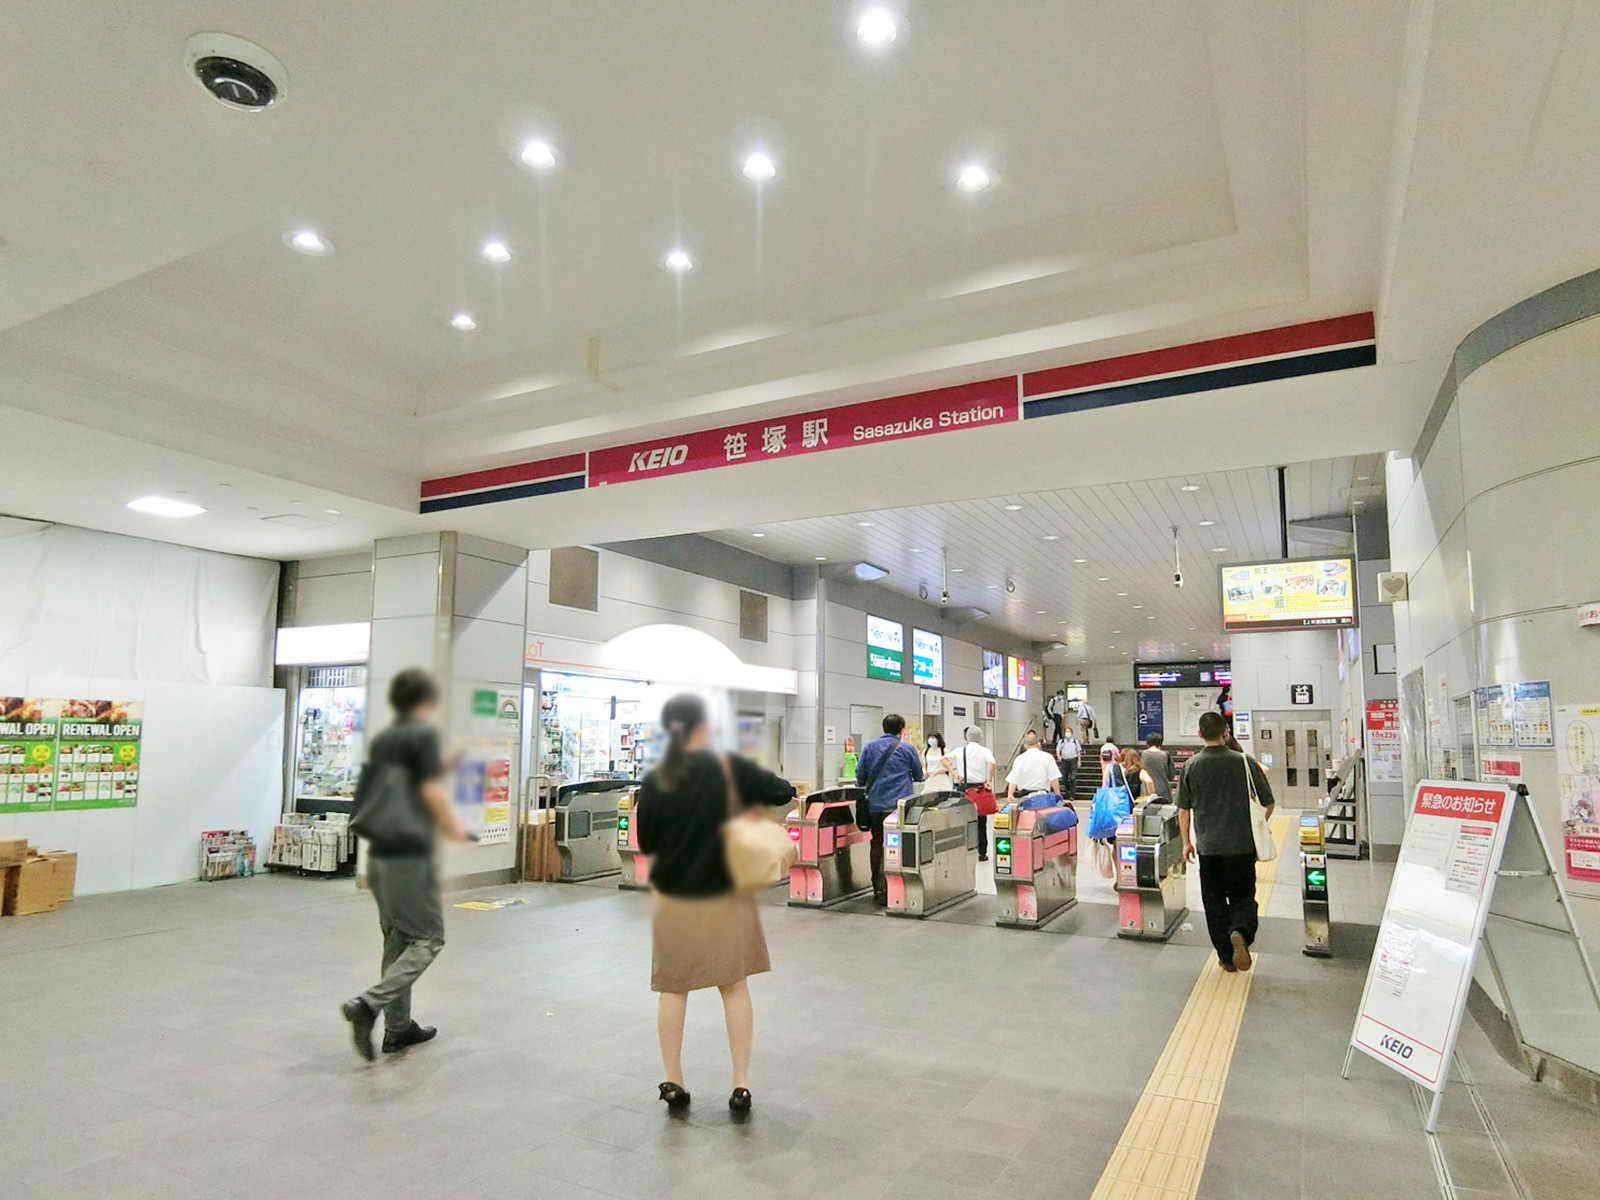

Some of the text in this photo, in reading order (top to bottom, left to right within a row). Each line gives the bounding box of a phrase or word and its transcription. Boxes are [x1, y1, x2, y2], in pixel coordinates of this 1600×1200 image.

[853, 405, 1004, 441] Sasazuka Station
[722, 418, 829, 461] 笹塚駅
[628, 444, 688, 473] KEIO
[1139, 713, 1148, 724] 2
[25, 722, 56, 736] OPEN
[62, 723, 140, 736] RENEWAL OPEN
[1421, 792, 1497, 815] 緊急のお知らせ
[887, 833, 899, 846] IC
[1121, 847, 1136, 860] IC
[1380, 1034, 1413, 1059] KEIO
